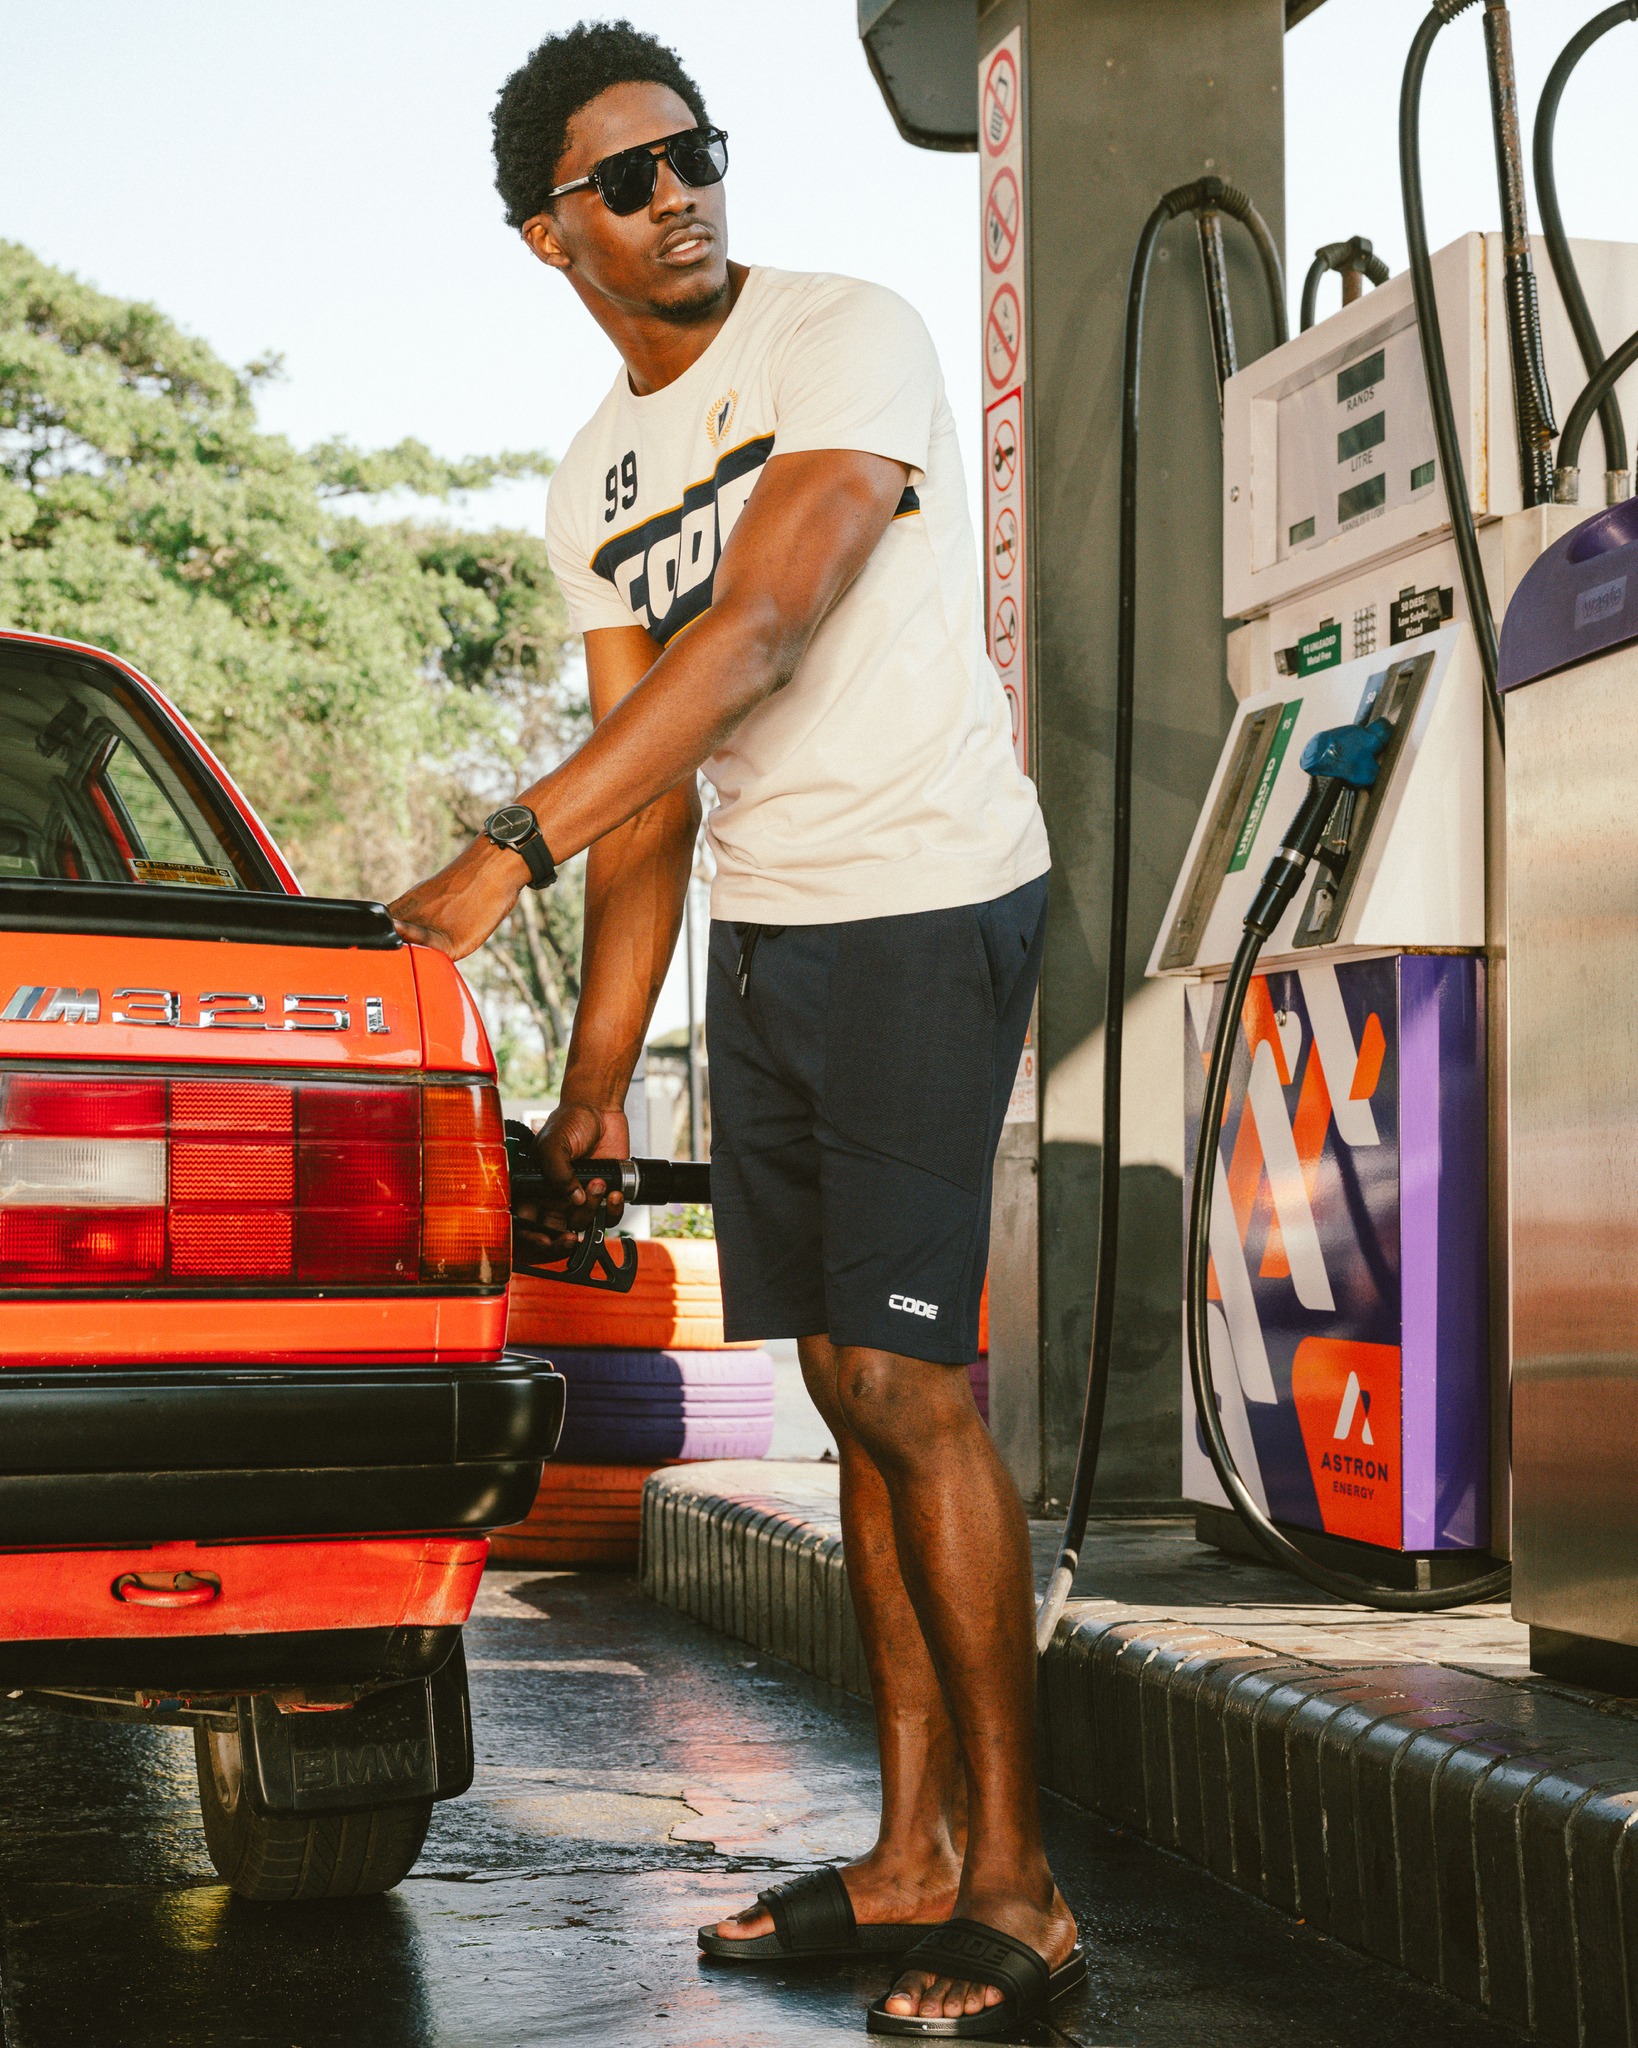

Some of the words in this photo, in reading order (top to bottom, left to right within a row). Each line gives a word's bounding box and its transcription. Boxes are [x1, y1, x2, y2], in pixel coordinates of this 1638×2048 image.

[1347, 387, 1375, 413] RANDS
[1351, 450, 1373, 472] LITRE
[605, 450, 638, 523] 99
[1398, 617, 1410, 627] Low
[1406, 622, 1423, 638] Diesel
[1310, 635, 1336, 652] UNLEADED
[1365, 690, 1377, 704] 50
[1282, 718, 1292, 731] 95
[1236, 758, 1276, 857] UNLEADED
[888, 1294, 938, 1320] CODE
[1321, 1452, 1388, 1483] ASTRON
[1333, 1480, 1374, 1500] ENERGY
[293, 1739, 430, 1792] BMW
